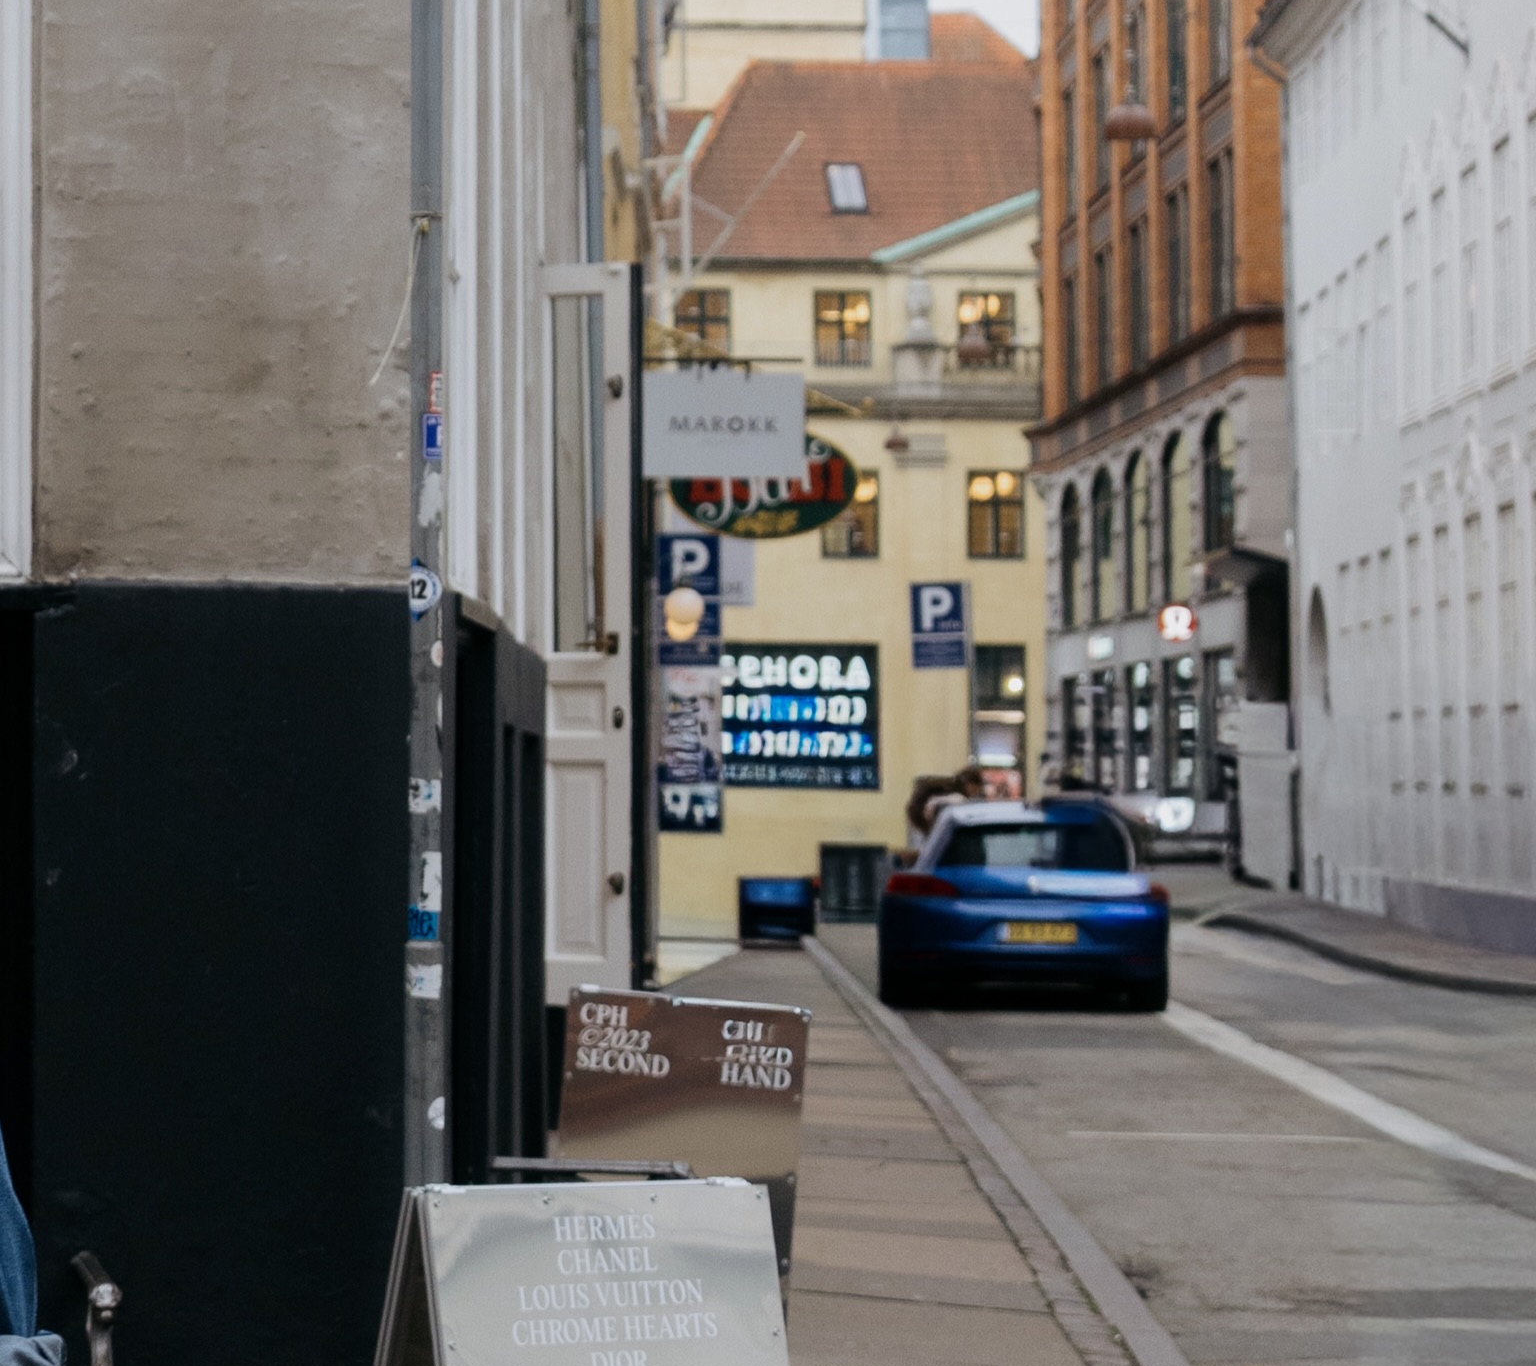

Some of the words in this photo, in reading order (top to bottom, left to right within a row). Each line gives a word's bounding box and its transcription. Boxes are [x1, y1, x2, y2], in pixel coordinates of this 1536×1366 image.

[579, 1002, 629, 1028] CPH
[575, 1046, 671, 1078] SECOND
[720, 1062, 792, 1091] HAND
[557, 1246, 658, 1275] CHANEL
[519, 1283, 590, 1311] LOUIS
[595, 1279, 703, 1307] VUITTON
[512, 1316, 618, 1346] CHROME
[624, 1311, 718, 1341] HEARTS
